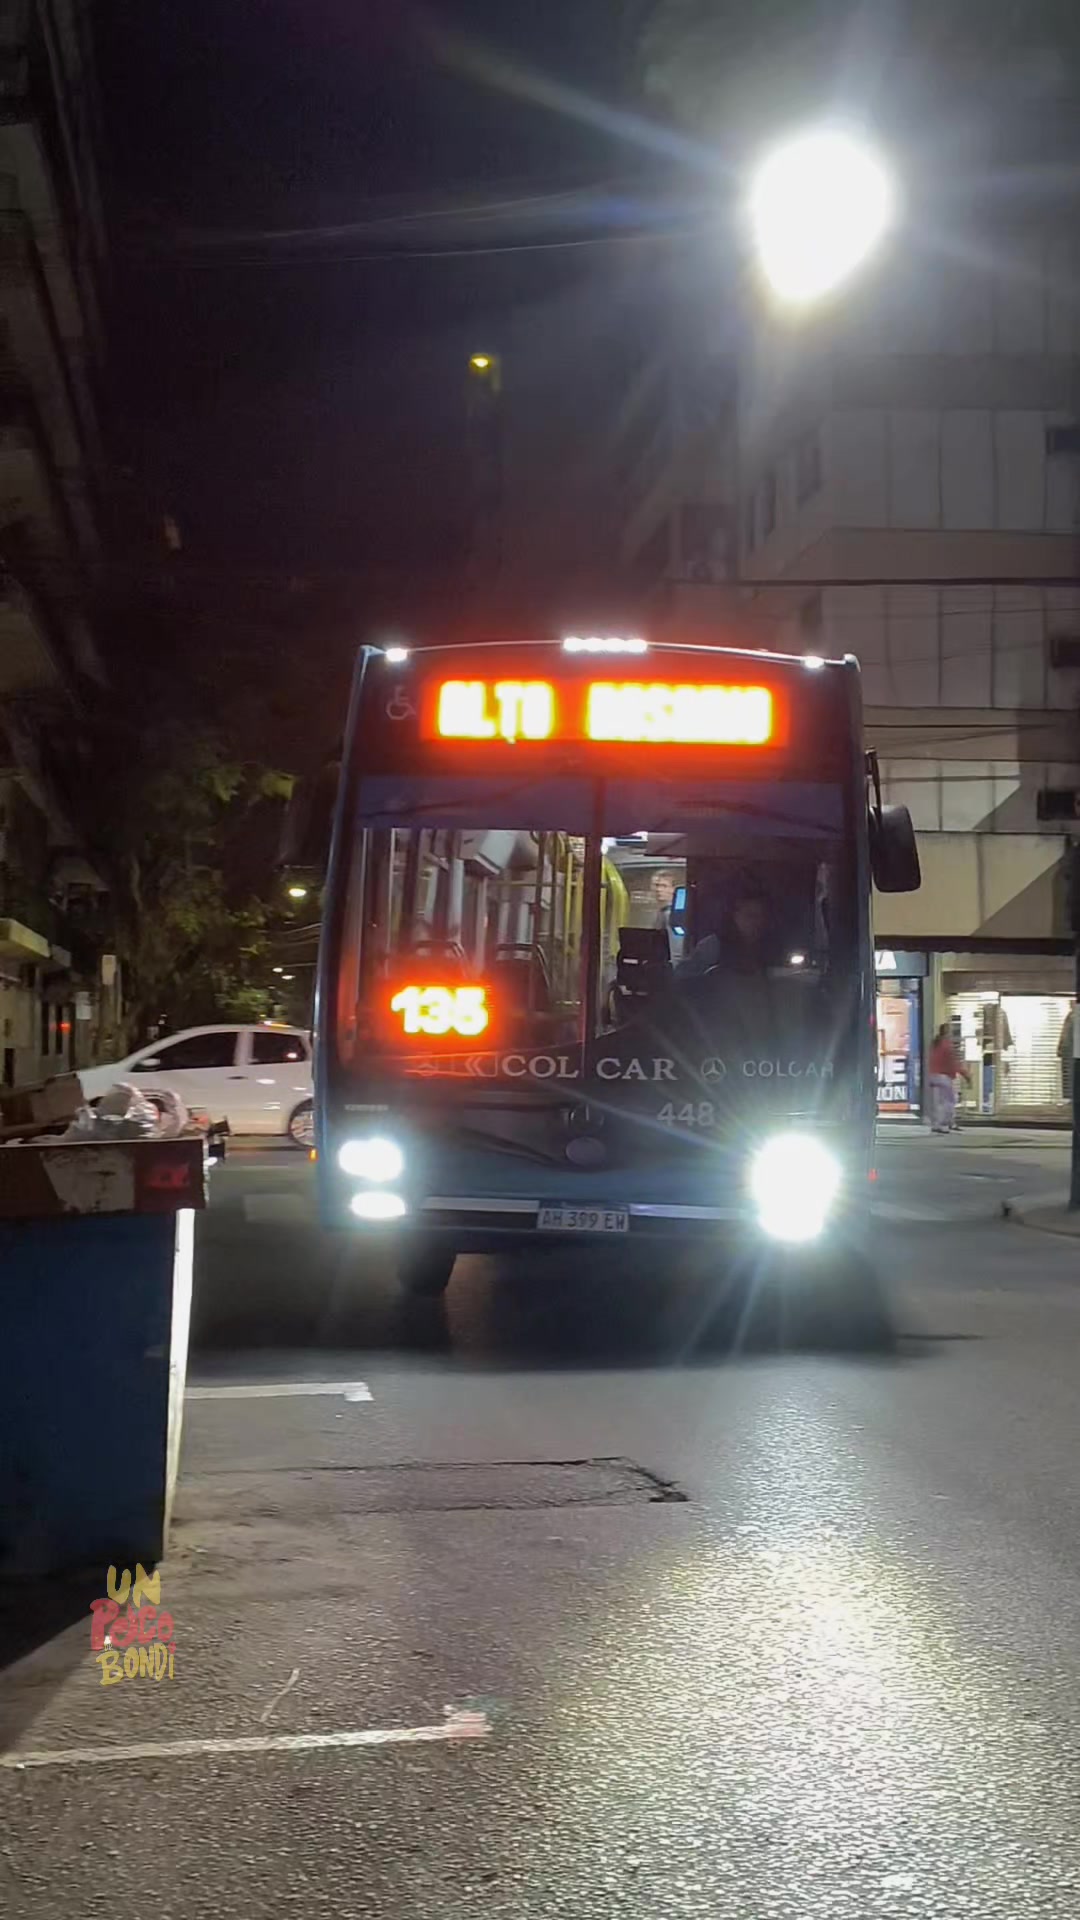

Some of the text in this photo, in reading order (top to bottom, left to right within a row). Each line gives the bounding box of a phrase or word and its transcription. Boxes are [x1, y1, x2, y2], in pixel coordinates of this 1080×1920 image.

[392, 986, 488, 1036] 135
[502, 1055, 678, 1080] COL CAR
[742, 1060, 835, 1079] COLCAR
[657, 1102, 714, 1127] 448
